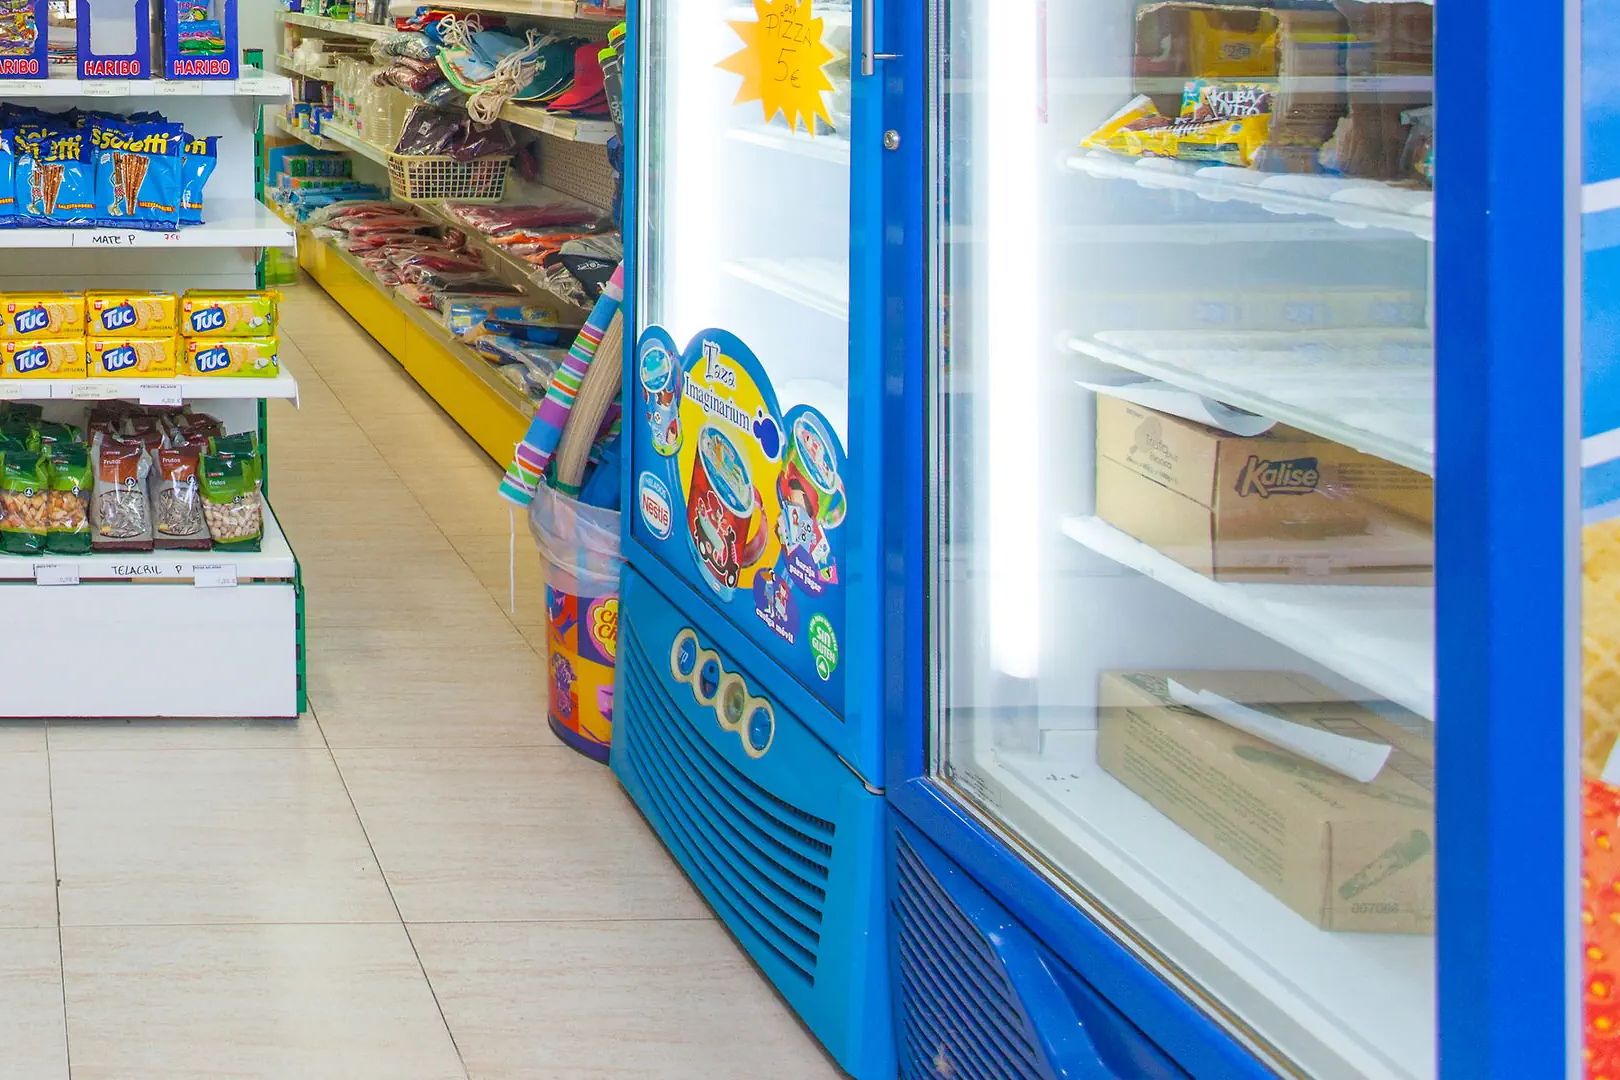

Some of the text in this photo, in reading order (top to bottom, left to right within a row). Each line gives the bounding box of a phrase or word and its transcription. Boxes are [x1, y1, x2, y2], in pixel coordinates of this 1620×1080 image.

[84, 60, 141, 76] HARIBO
[174, 59, 230, 75] HARIBO
[128, 234, 136, 246] P
[17, 313, 48, 332] TUC
[103, 311, 134, 330] TUC
[193, 312, 223, 331] TUC
[16, 354, 47, 373] TUC
[104, 352, 134, 371] TUC
[197, 353, 228, 373] TUC
[703, 341, 737, 388] Taza
[684, 374, 751, 432] Imaginarium
[1241, 455, 1320, 498] Kalise
[175, 565, 183, 575] P
